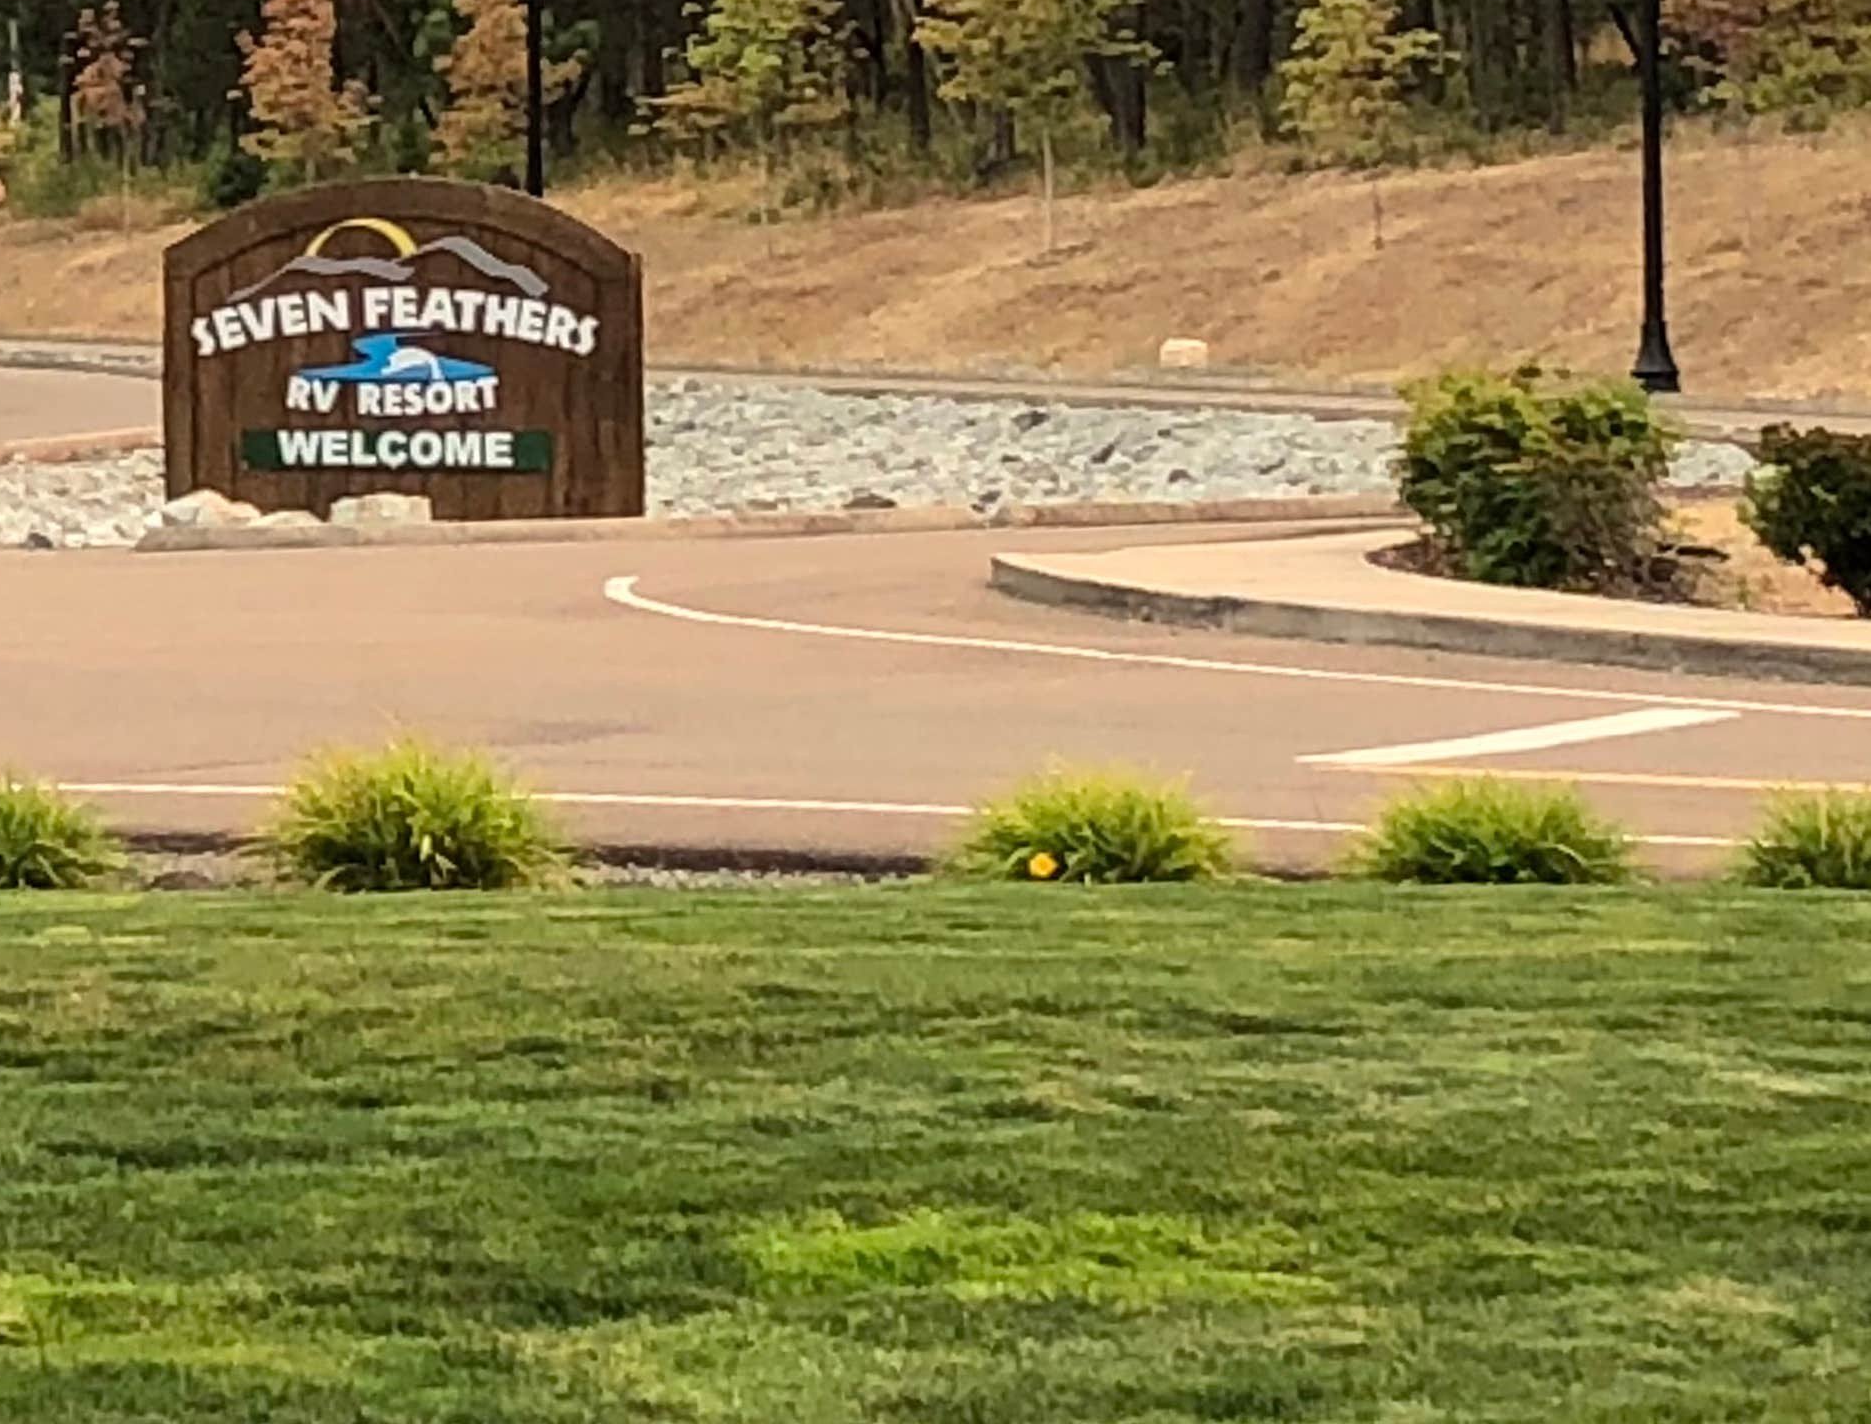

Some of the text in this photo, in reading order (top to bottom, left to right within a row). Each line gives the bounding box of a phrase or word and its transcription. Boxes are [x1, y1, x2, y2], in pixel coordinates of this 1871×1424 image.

[191, 286, 601, 357] SEVEN FEATHERS
[286, 376, 499, 417] RV RESORT
[276, 430, 514, 469] WELCOME
